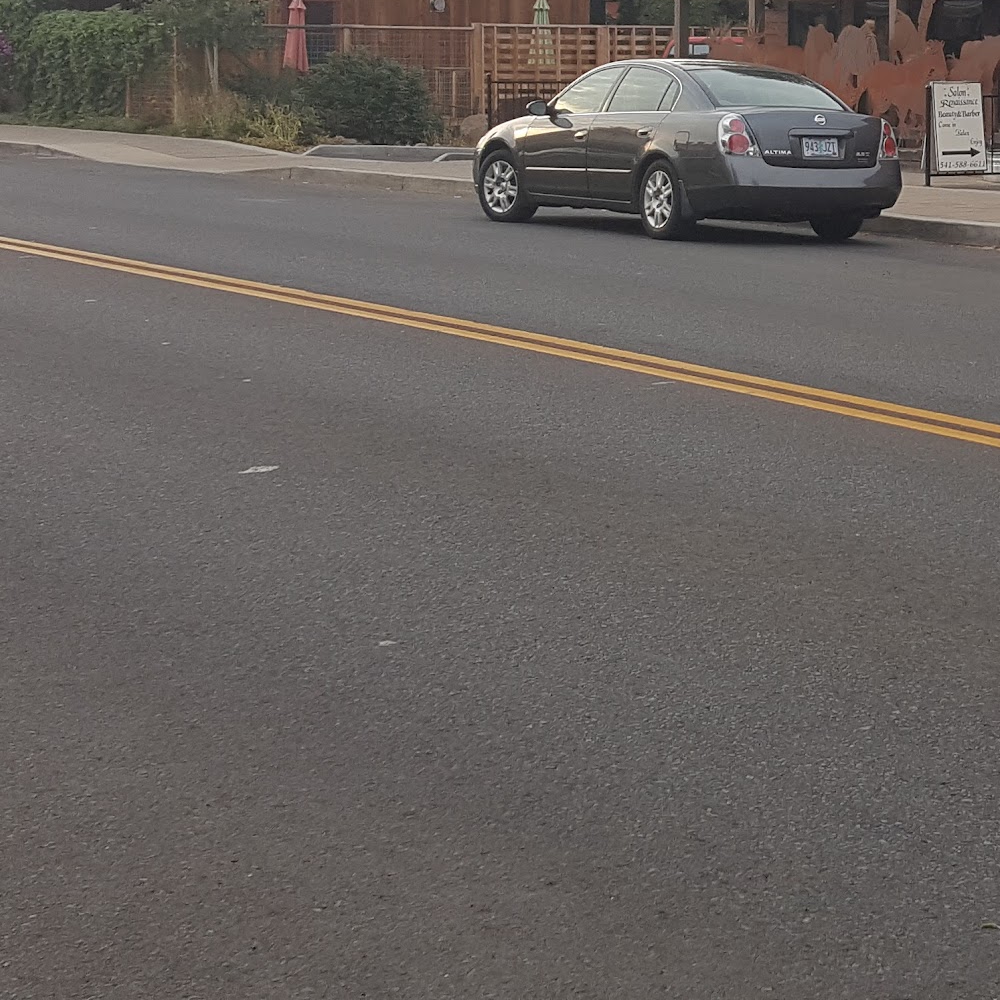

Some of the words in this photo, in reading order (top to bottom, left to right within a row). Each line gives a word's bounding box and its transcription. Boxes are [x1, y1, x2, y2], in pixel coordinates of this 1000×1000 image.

[947, 85, 967, 97] Salon
[940, 98, 978, 108] Renaissance
[805, 141, 819, 152] 943
